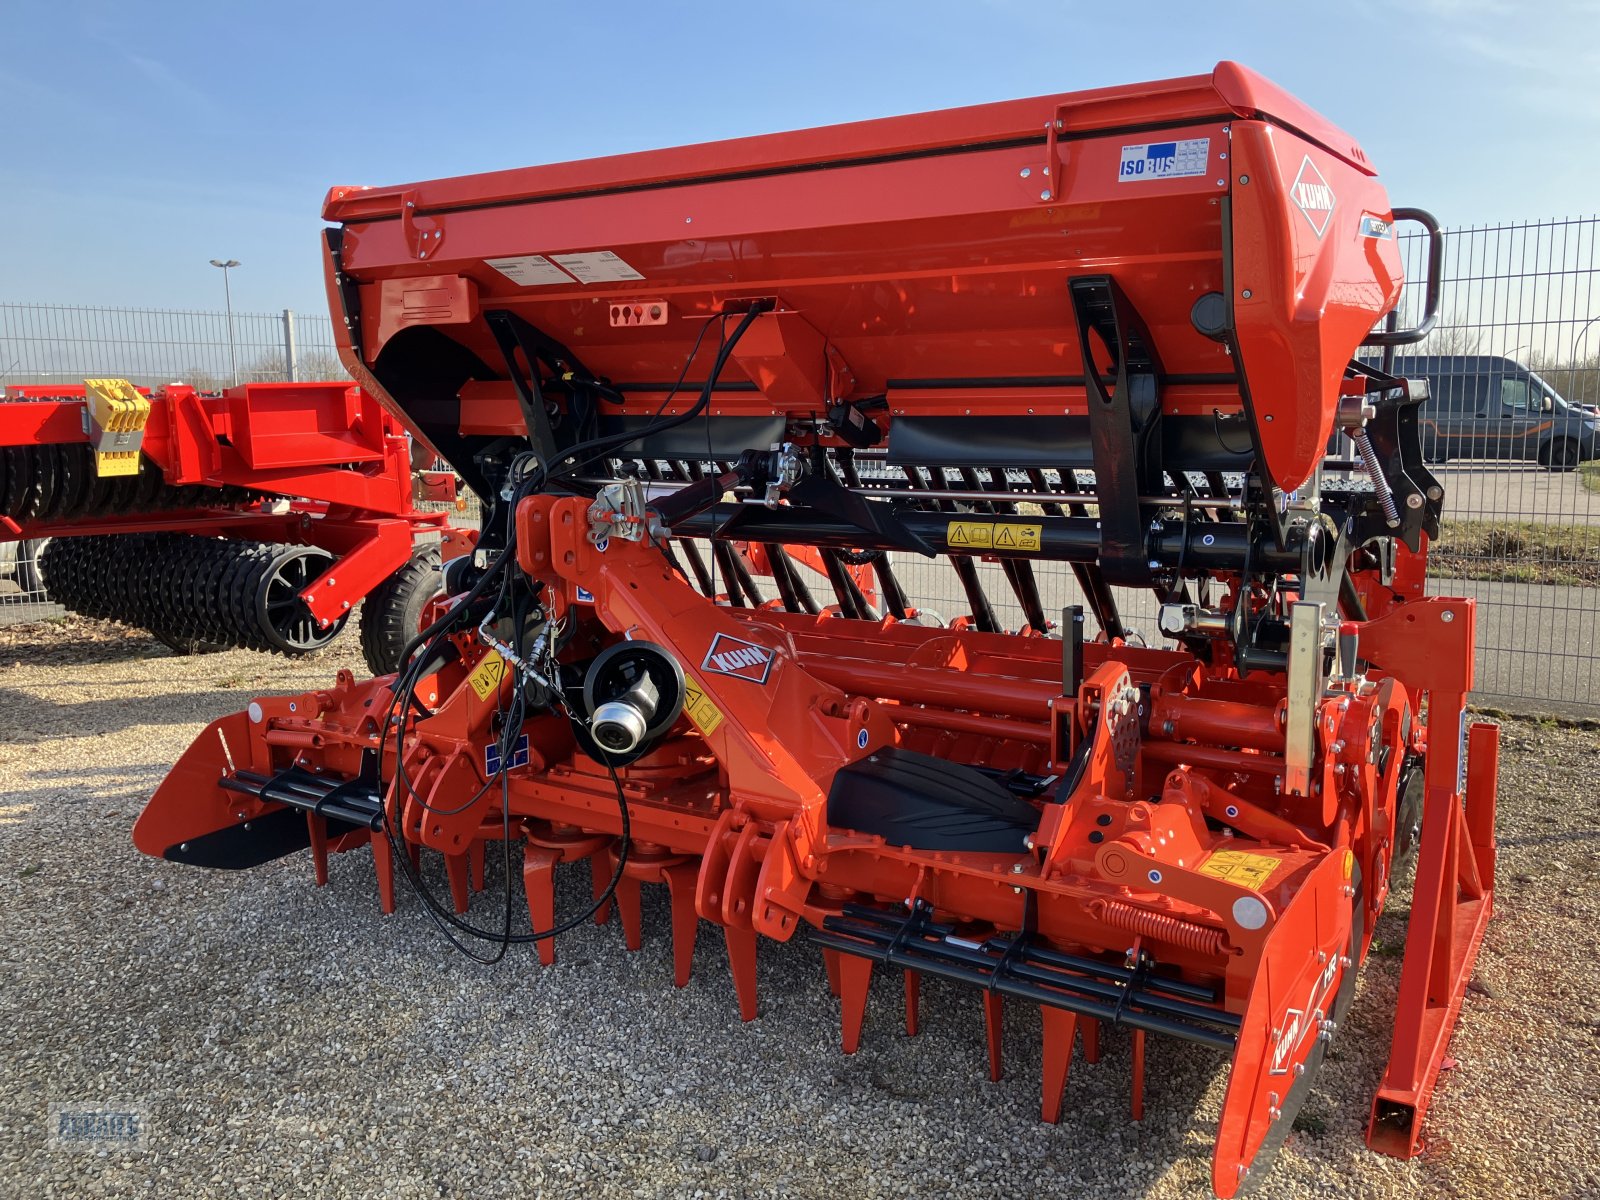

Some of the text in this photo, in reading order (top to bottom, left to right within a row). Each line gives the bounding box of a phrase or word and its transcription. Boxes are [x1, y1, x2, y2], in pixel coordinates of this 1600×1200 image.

[1297, 182, 1332, 210] KUHN
[710, 646, 770, 672] KUHN
[1323, 952, 1337, 989] HR
[1275, 1013, 1299, 1071] KUHN
